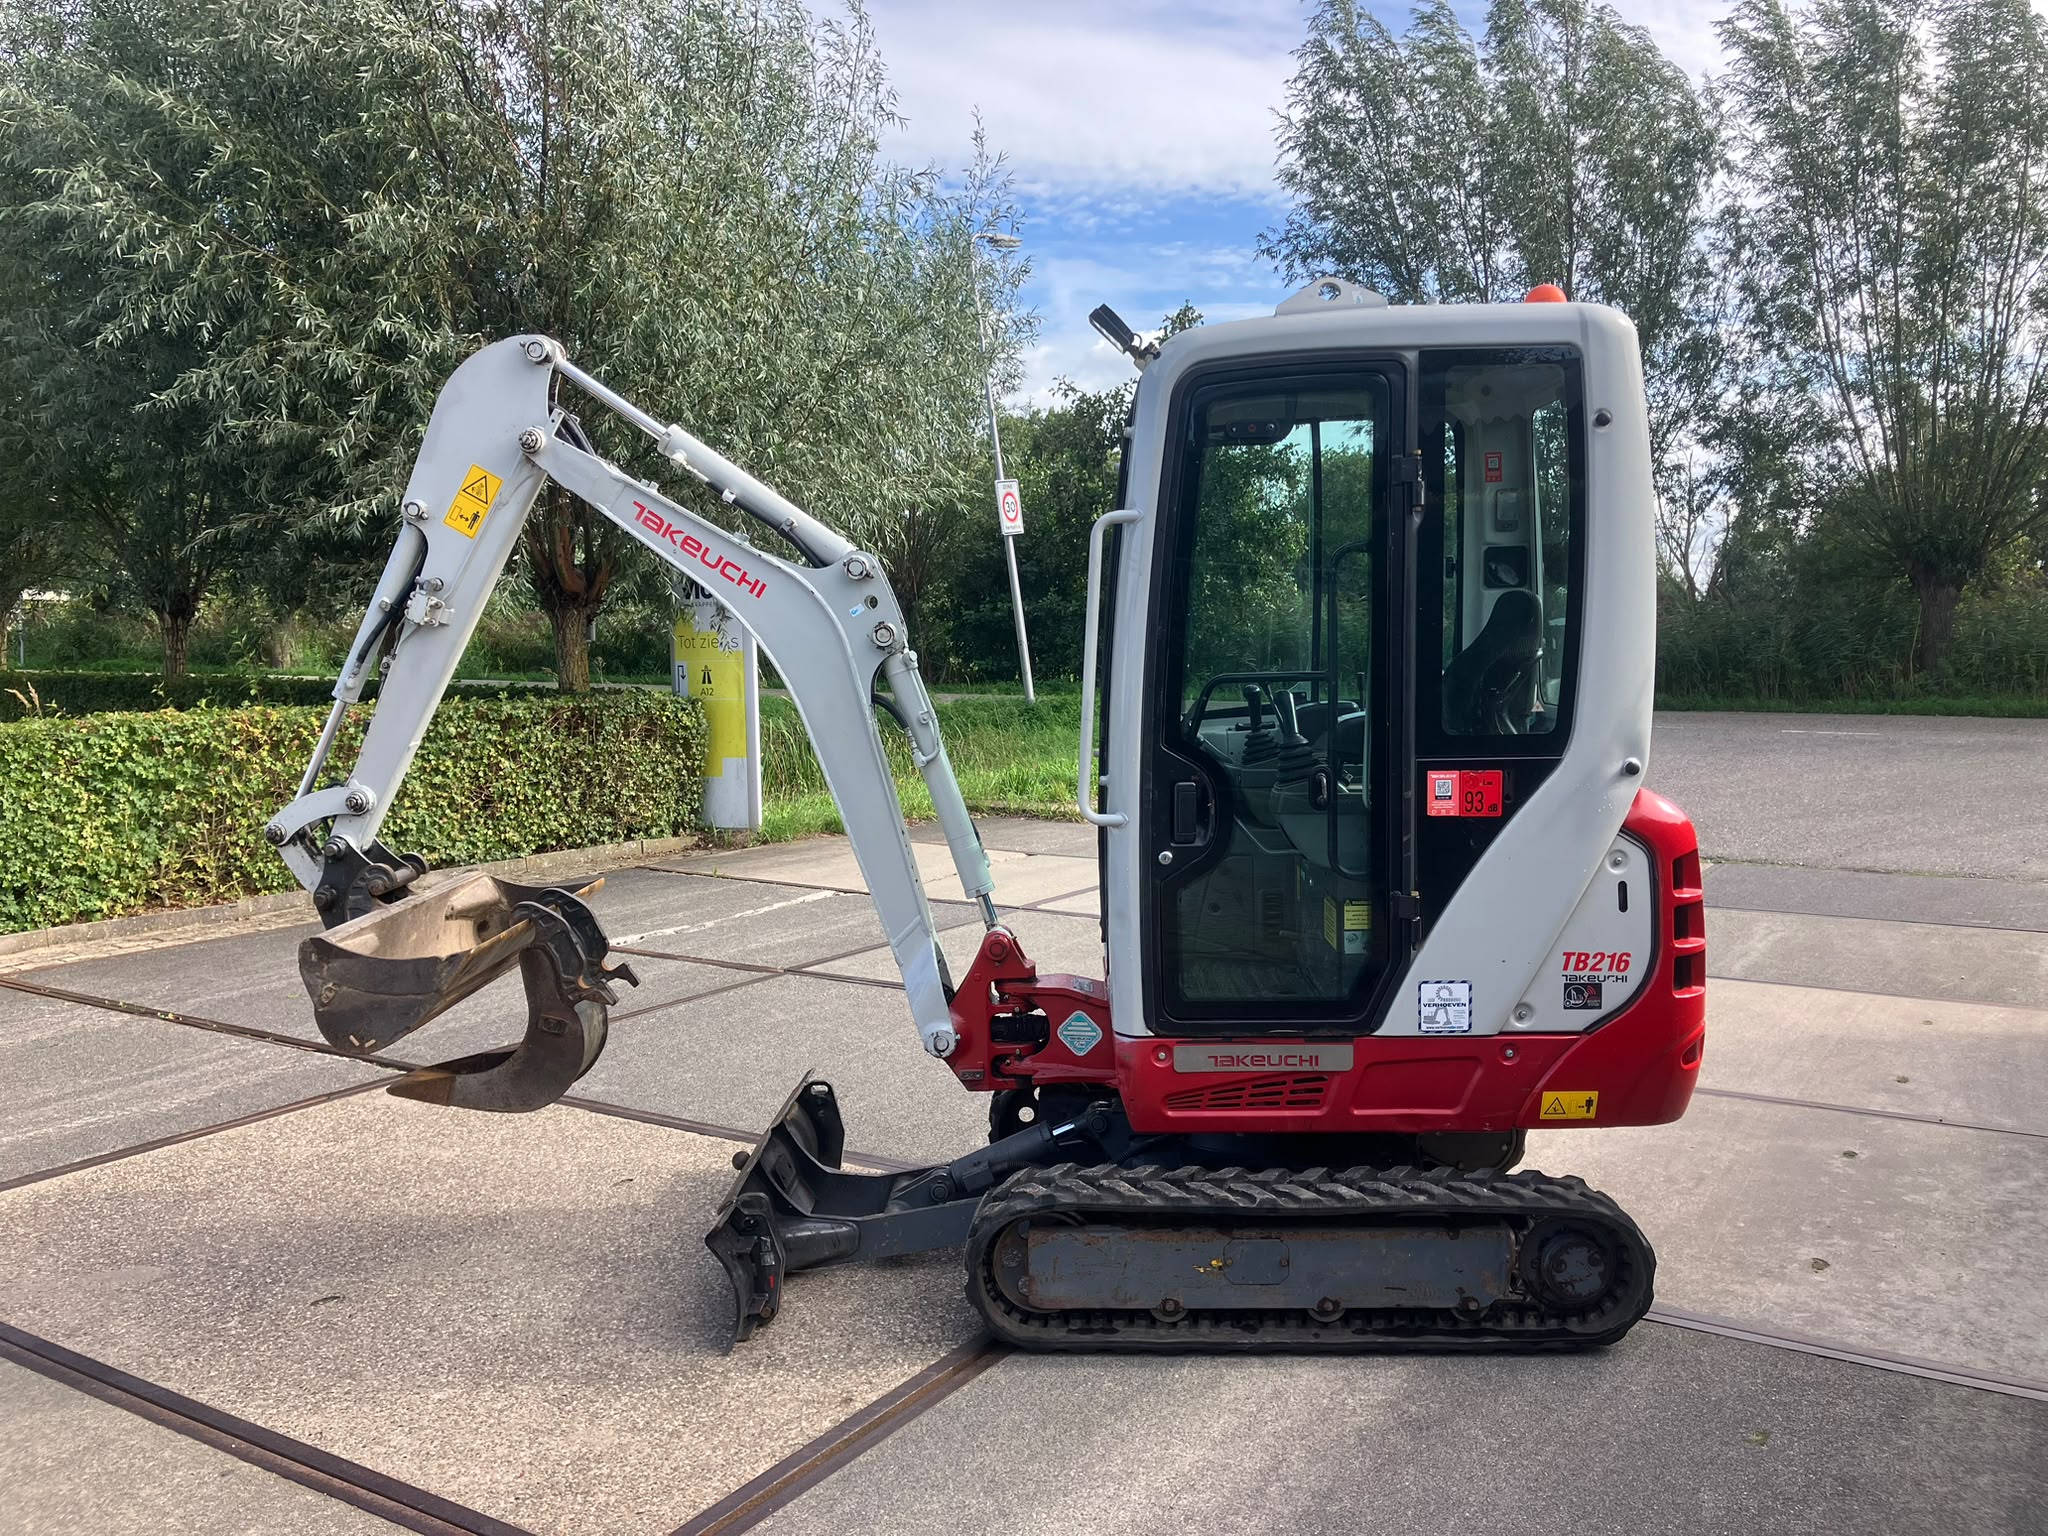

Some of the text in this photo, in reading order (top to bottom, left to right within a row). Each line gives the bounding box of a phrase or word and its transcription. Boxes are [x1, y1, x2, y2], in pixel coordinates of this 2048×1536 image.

[1005, 501, 1016, 513] 30
[632, 501, 767, 598] TAKEUCHI
[678, 634, 739, 649] Tot zies
[700, 687, 714, 696] A12
[1464, 791, 1484, 813] 93
[1562, 952, 1632, 973] TB216
[1207, 1055, 1319, 1067] TAKEUCHI
